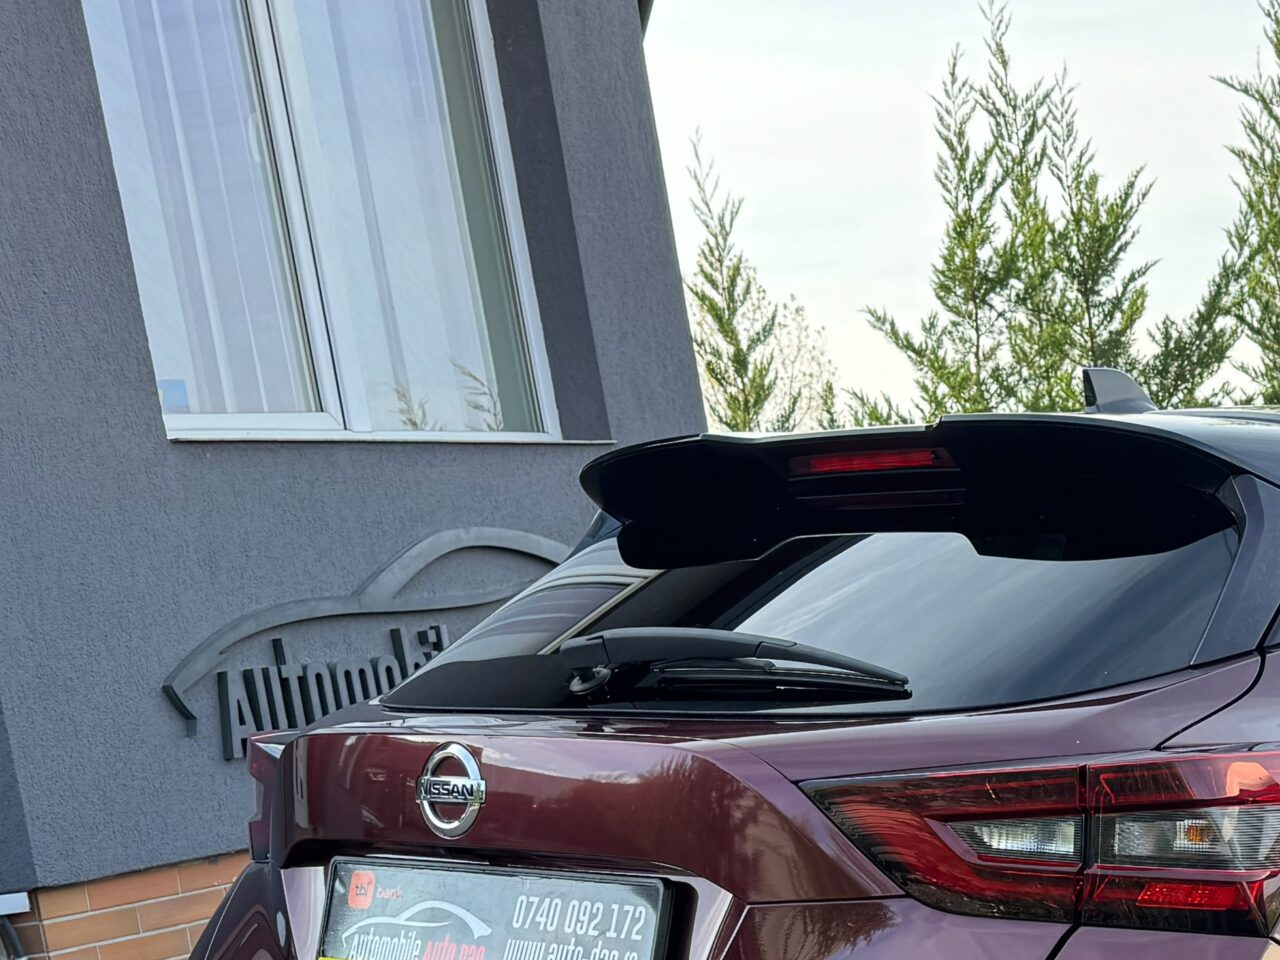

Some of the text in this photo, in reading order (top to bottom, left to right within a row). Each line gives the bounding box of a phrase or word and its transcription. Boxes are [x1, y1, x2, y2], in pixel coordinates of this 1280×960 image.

[420, 782, 475, 798] NISSAN
[512, 895, 646, 941] 0740 092 172
